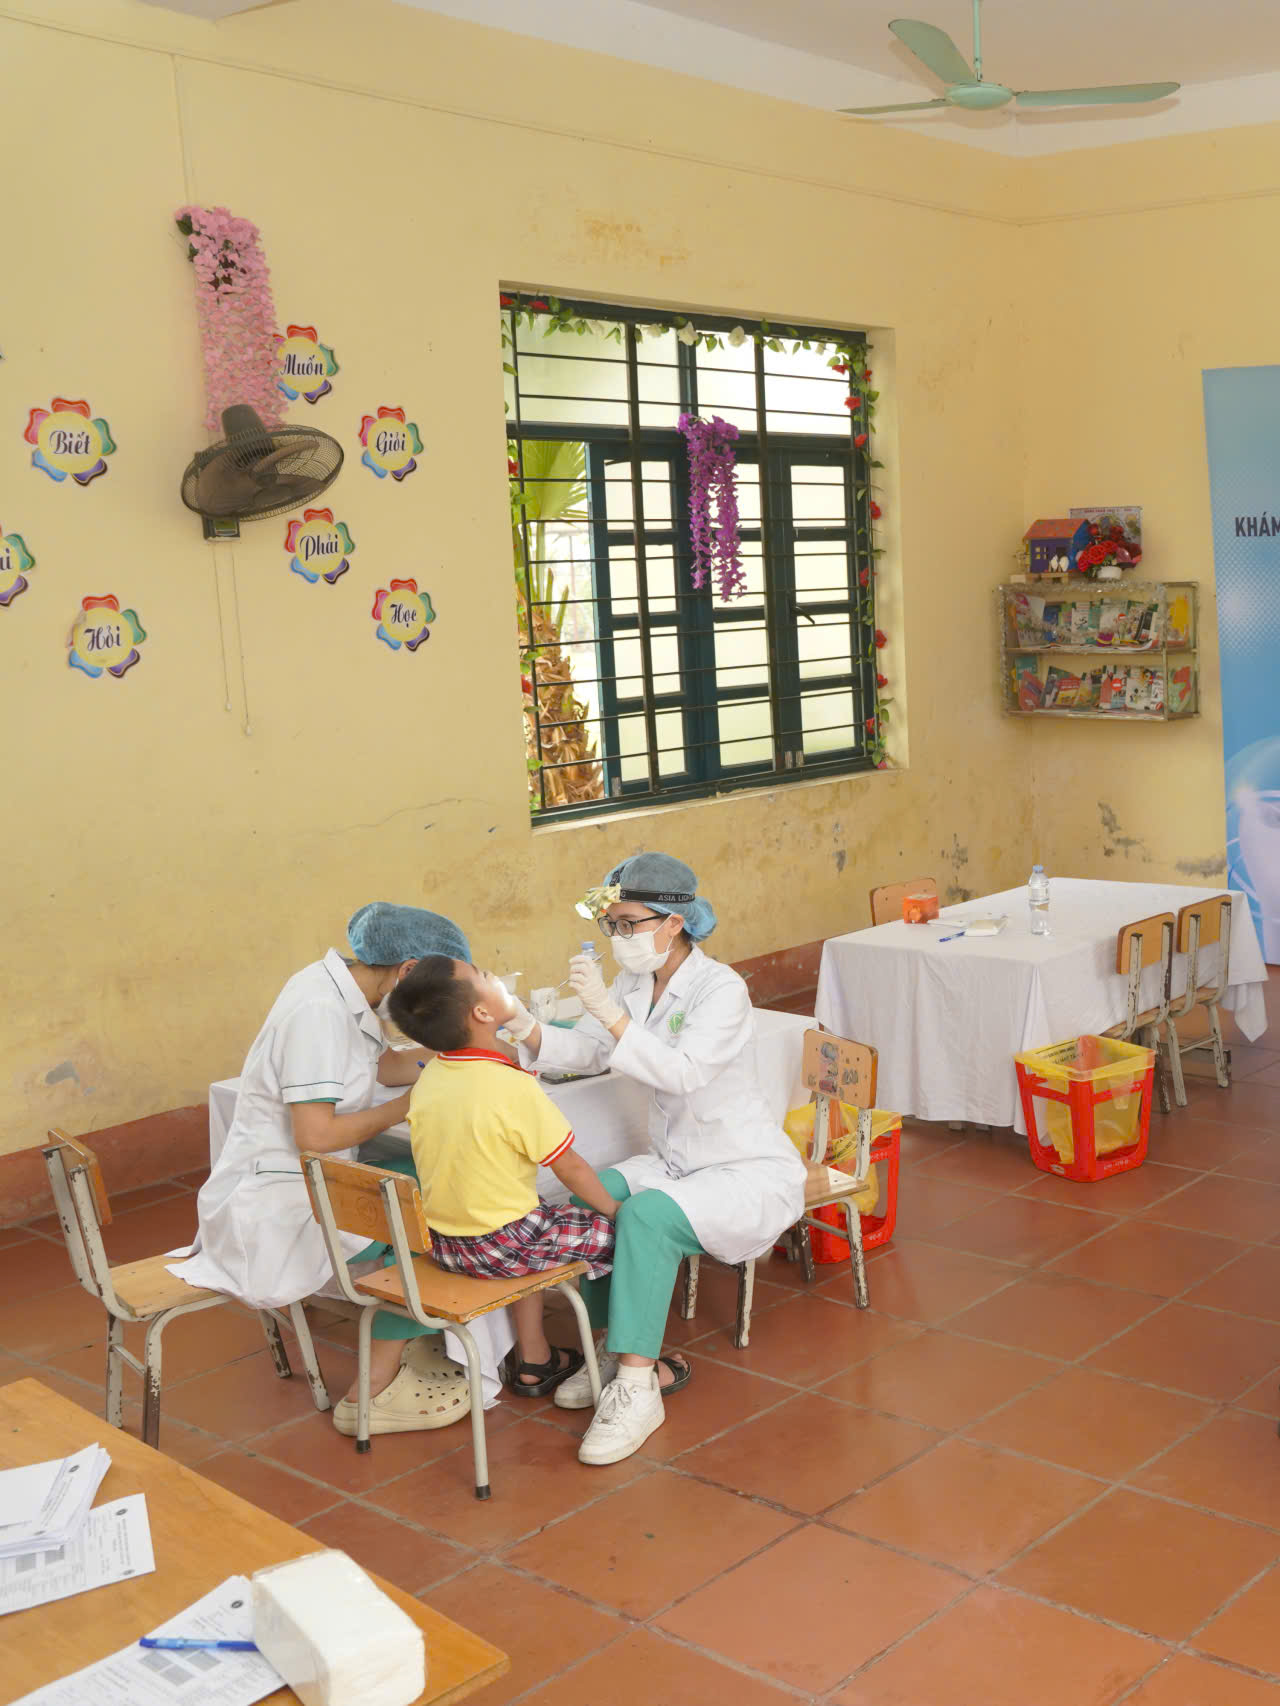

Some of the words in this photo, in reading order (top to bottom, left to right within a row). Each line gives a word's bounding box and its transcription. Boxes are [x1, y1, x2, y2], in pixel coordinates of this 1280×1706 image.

[280, 353, 324, 376] Muốn
[49, 430, 90, 455] Biết
[376, 431, 406, 456] Giỏi
[299, 533, 340, 562] Phải
[390, 602, 417, 628] Học
[84, 624, 121, 652] Hỏi
[657, 894, 676, 902] ASIA
